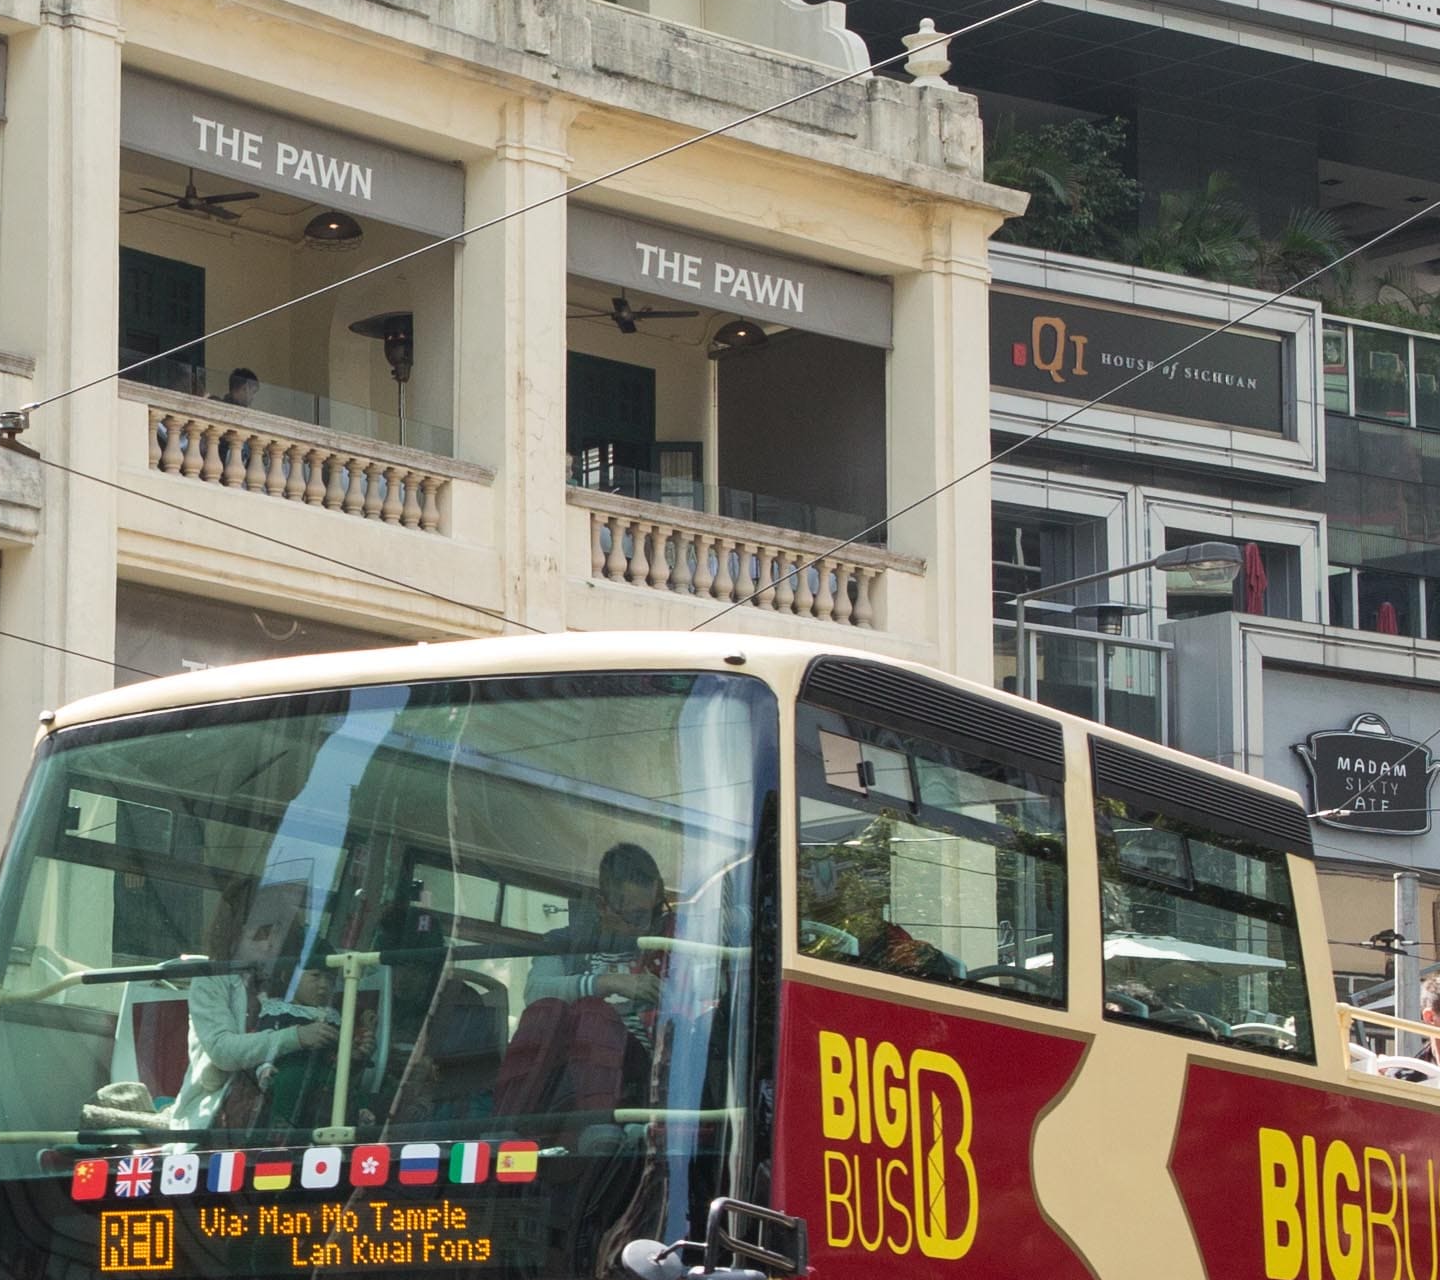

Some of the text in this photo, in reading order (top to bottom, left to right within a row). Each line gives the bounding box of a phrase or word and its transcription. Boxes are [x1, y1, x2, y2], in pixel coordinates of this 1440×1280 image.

[192, 116, 373, 201] THE PAWN
[636, 241, 805, 314] THE PAWN
[1101, 352, 1258, 390] HOUSE of SICHUAN
[1337, 756, 1407, 778] MADAM
[1345, 777, 1399, 797] SIXTY
[818, 1031, 908, 1151] BIG
[199, 1207, 249, 1238] Via:
[259, 1206, 311, 1236] Man
[323, 1203, 359, 1234] Mo
[823, 1151, 913, 1256] BUS
[102, 1210, 172, 1270] RED
[292, 1232, 491, 1268] Lan Kwai Fong
